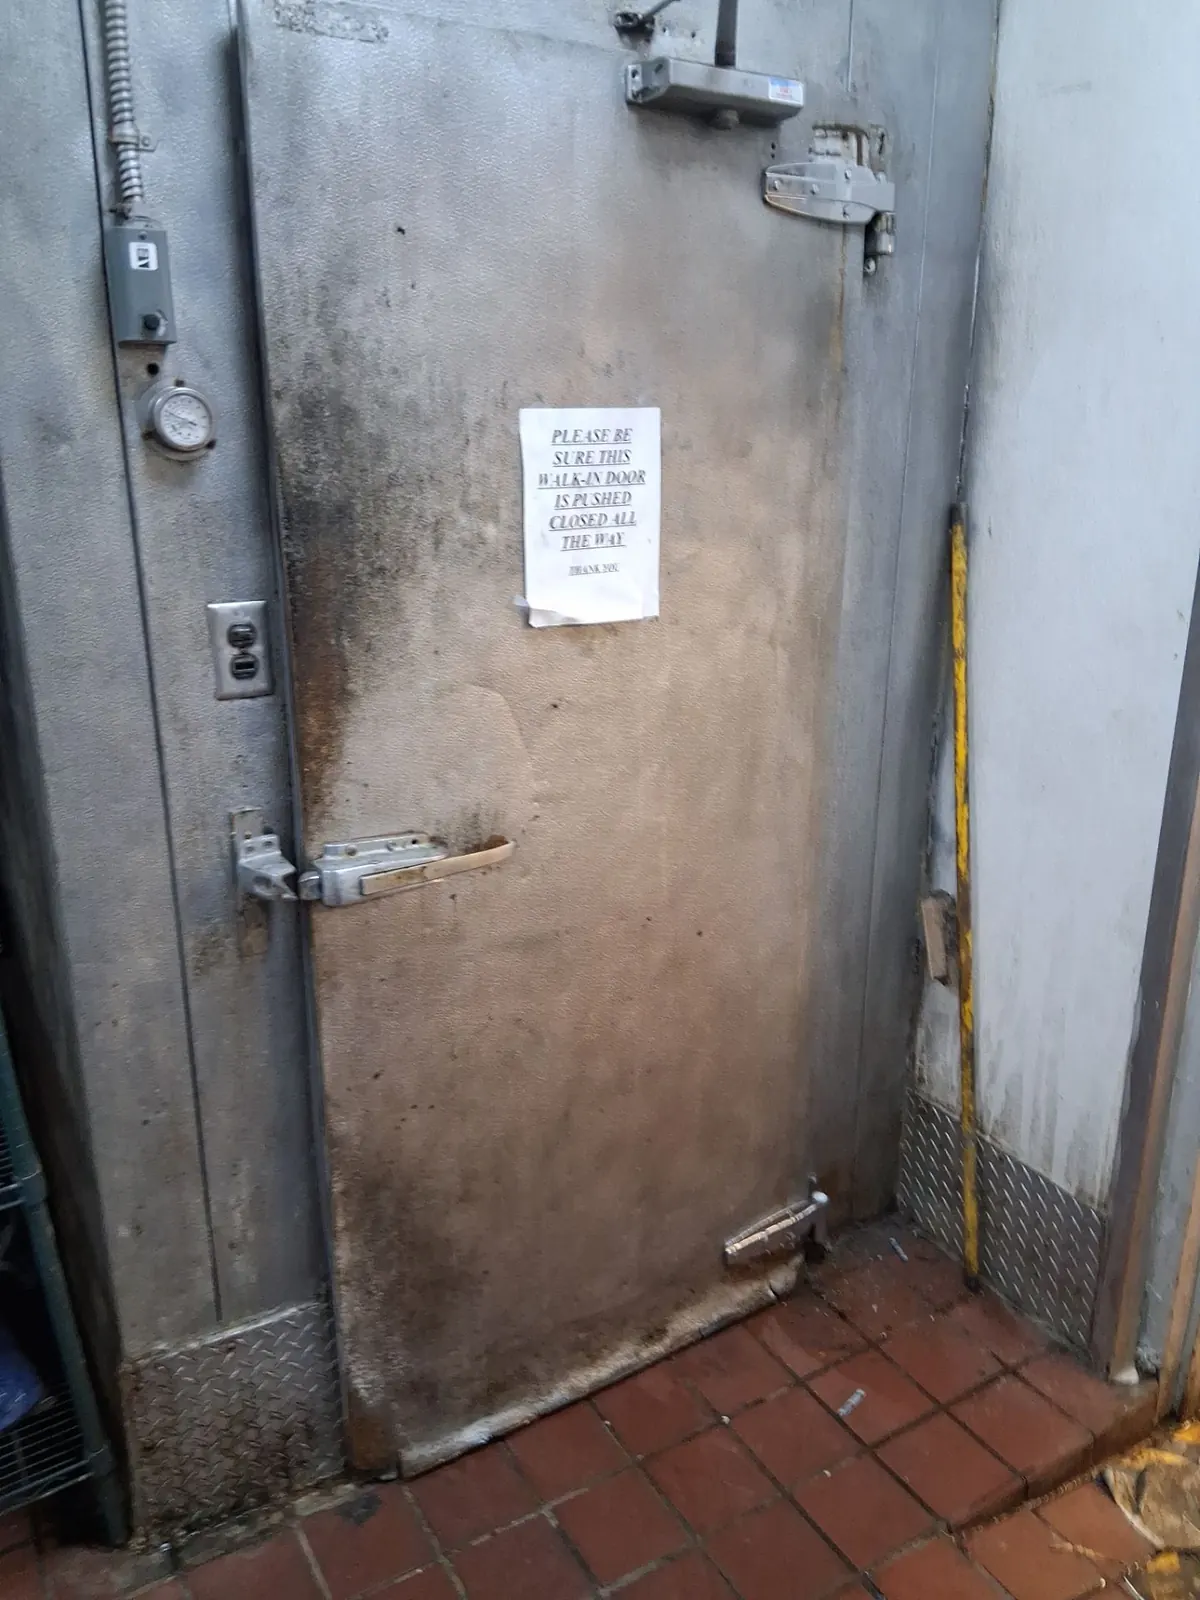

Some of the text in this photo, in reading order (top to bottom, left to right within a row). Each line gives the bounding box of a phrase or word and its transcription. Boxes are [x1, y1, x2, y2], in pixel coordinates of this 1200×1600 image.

[552, 428, 633, 444] PLEASE BE
[553, 449, 632, 466] SURE THIS
[538, 470, 646, 487] WALK-IN DOOR
[555, 491, 632, 509] IS PUSHED
[549, 511, 637, 530] CLOSED ALL
[562, 532, 625, 550] THE WAY
[569, 565, 601, 576] THANK
